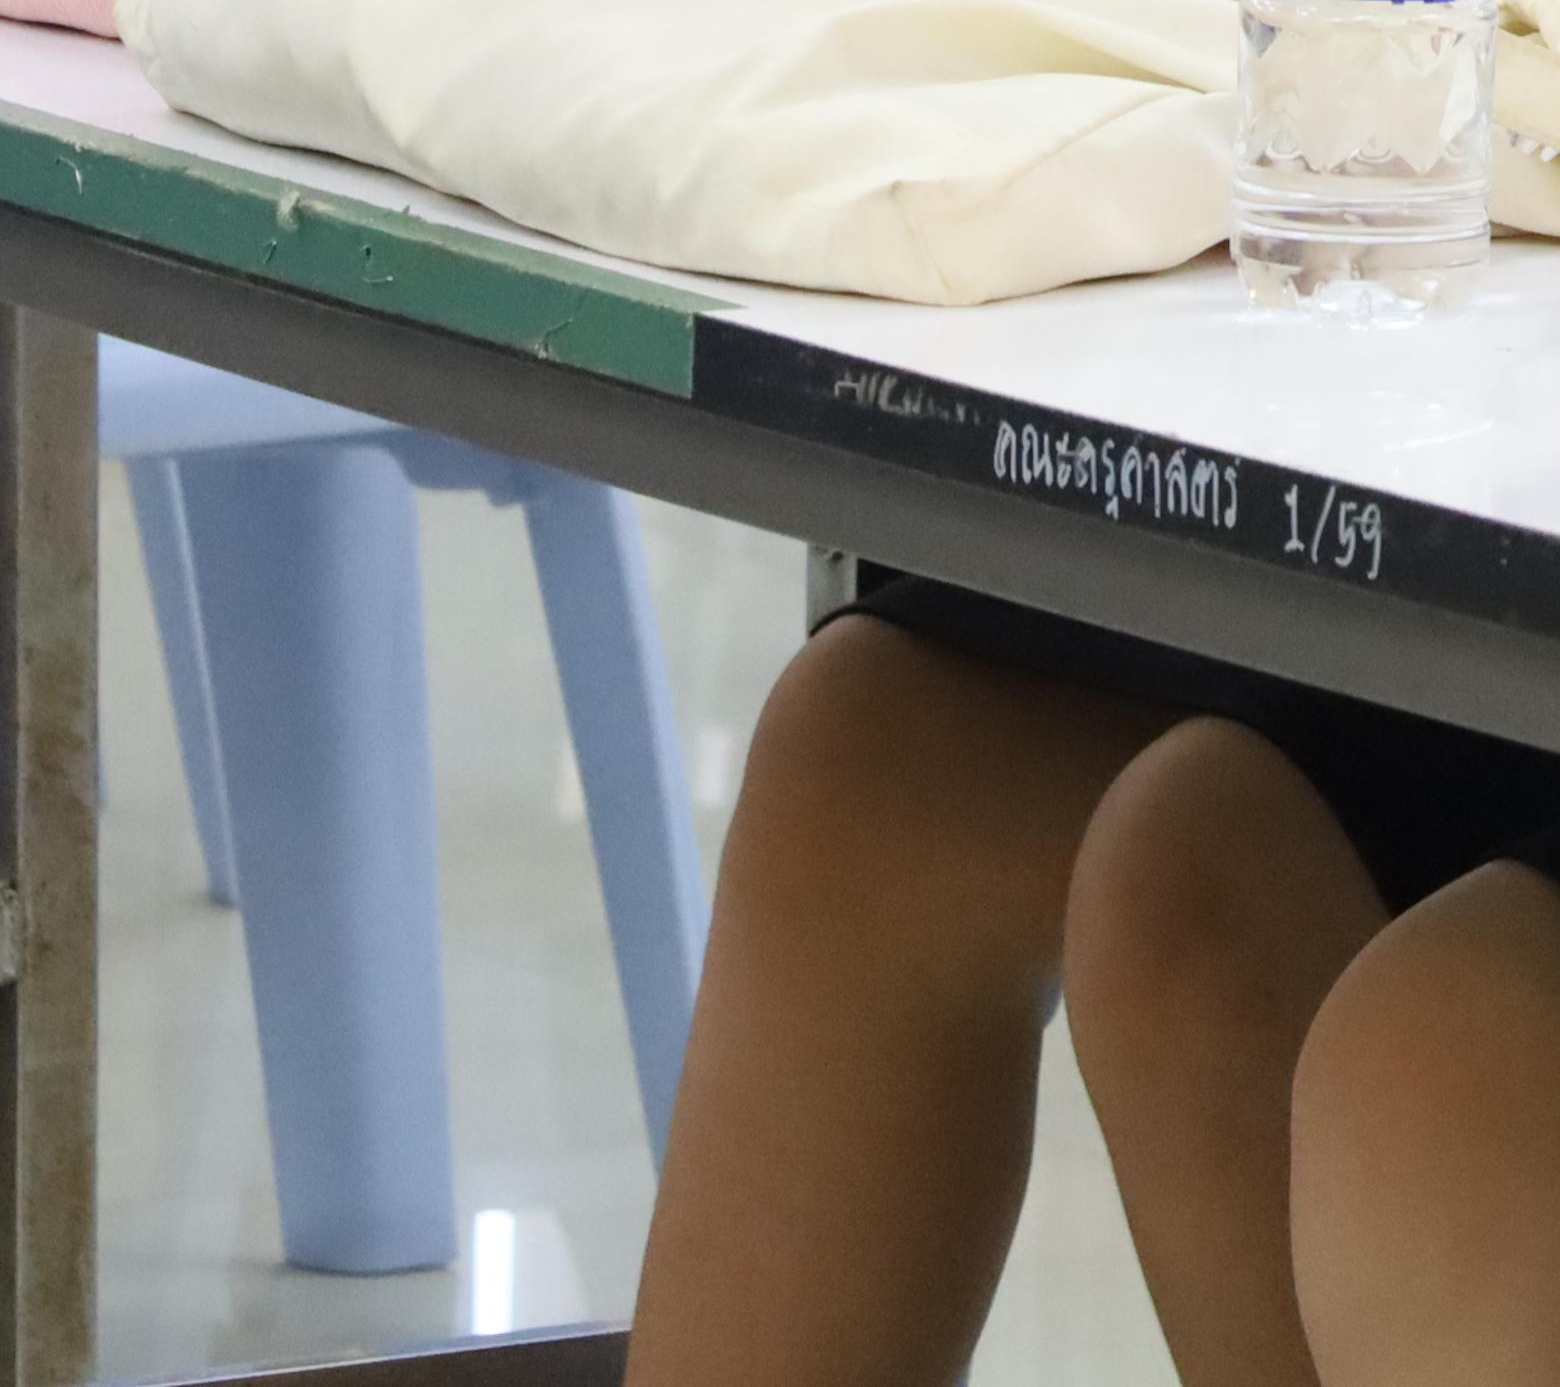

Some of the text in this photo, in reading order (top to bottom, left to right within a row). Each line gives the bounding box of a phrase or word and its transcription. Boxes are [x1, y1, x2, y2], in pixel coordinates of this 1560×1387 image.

[993, 419, 1382, 581] คณะครุศาสตร์ 1/59
